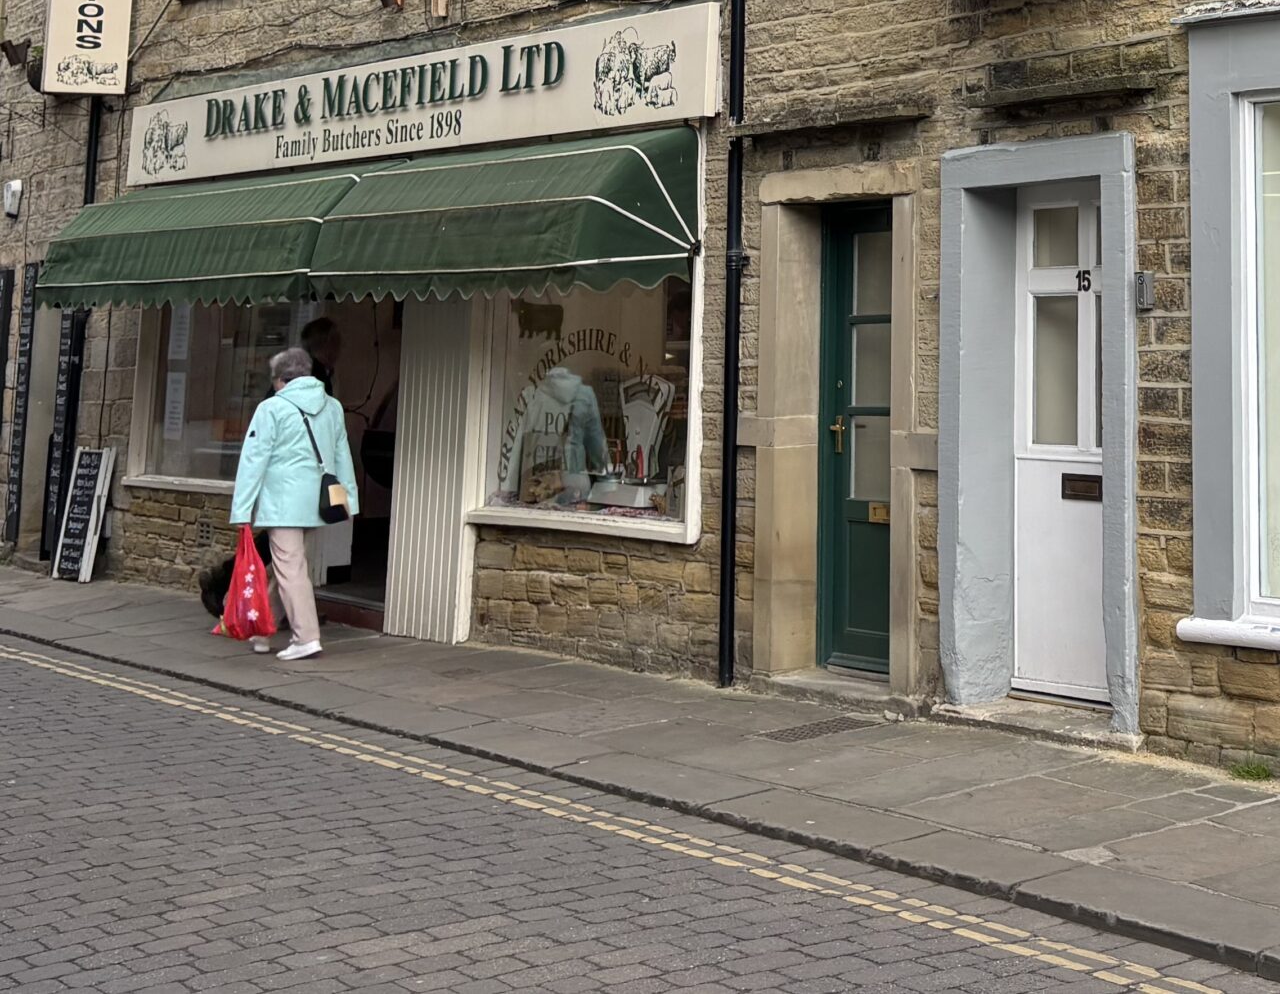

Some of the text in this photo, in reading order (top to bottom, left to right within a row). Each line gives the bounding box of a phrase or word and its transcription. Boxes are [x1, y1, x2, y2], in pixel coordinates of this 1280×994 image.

[204, 40, 566, 140] DRAKE & MACEFIELD LTD
[275, 109, 462, 161] Family Butchers Since 1898
[1075, 270, 1091, 292] 15
[497, 386, 530, 483] GREAT
[527, 327, 617, 399] YORKSHIRE
[619, 341, 632, 367] &
